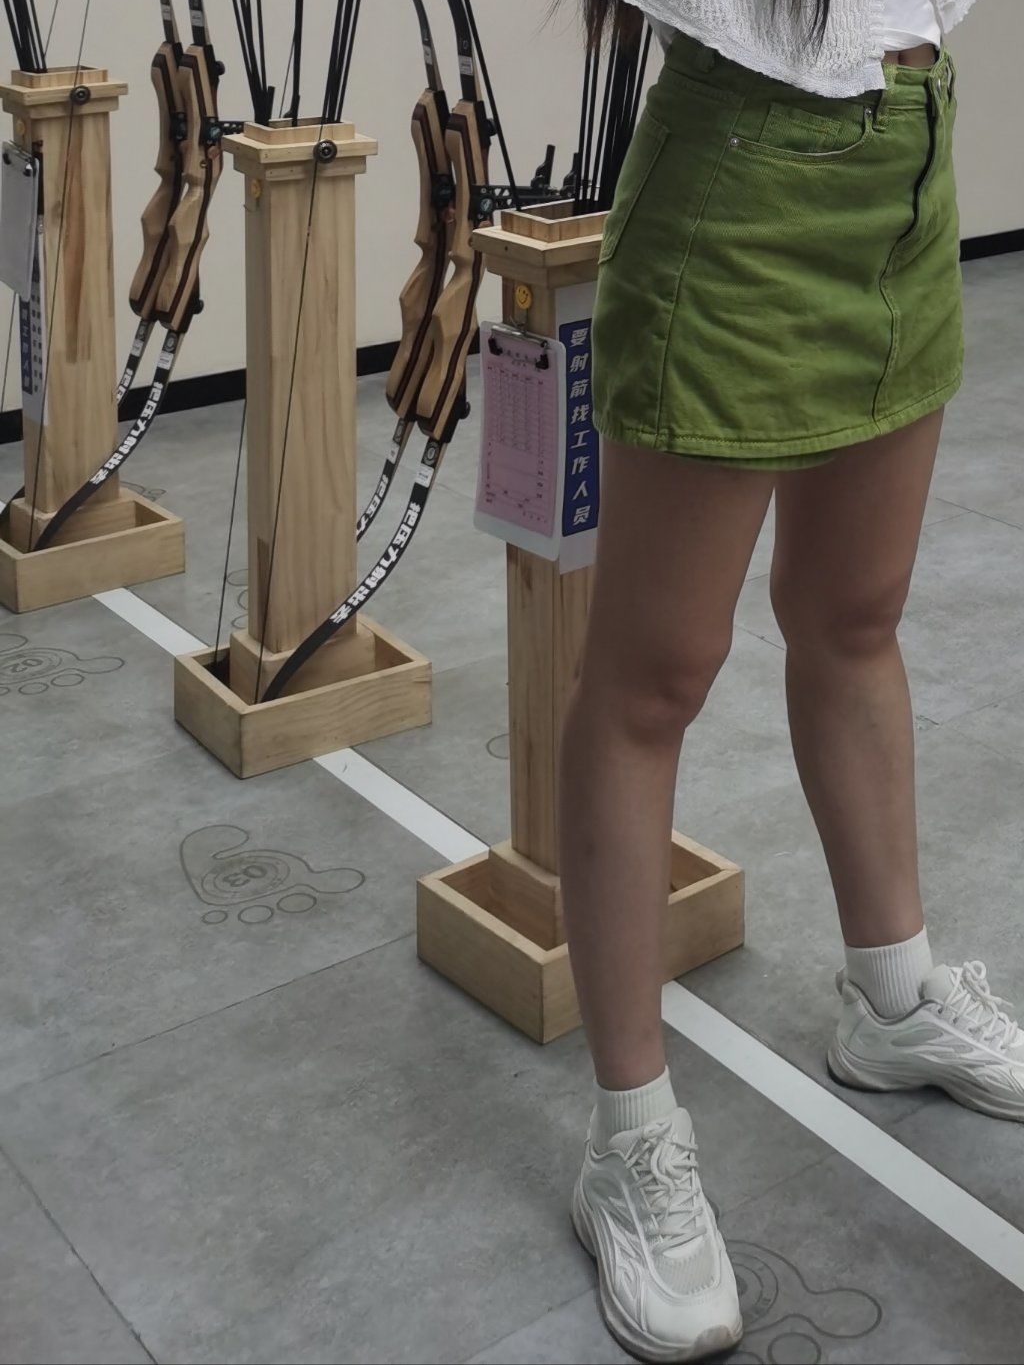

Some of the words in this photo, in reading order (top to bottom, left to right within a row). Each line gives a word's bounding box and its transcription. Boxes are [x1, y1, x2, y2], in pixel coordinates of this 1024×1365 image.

[570, 327, 590, 524] 要射箭找工作人员
[330, 502, 421, 624] 把压力射出去
